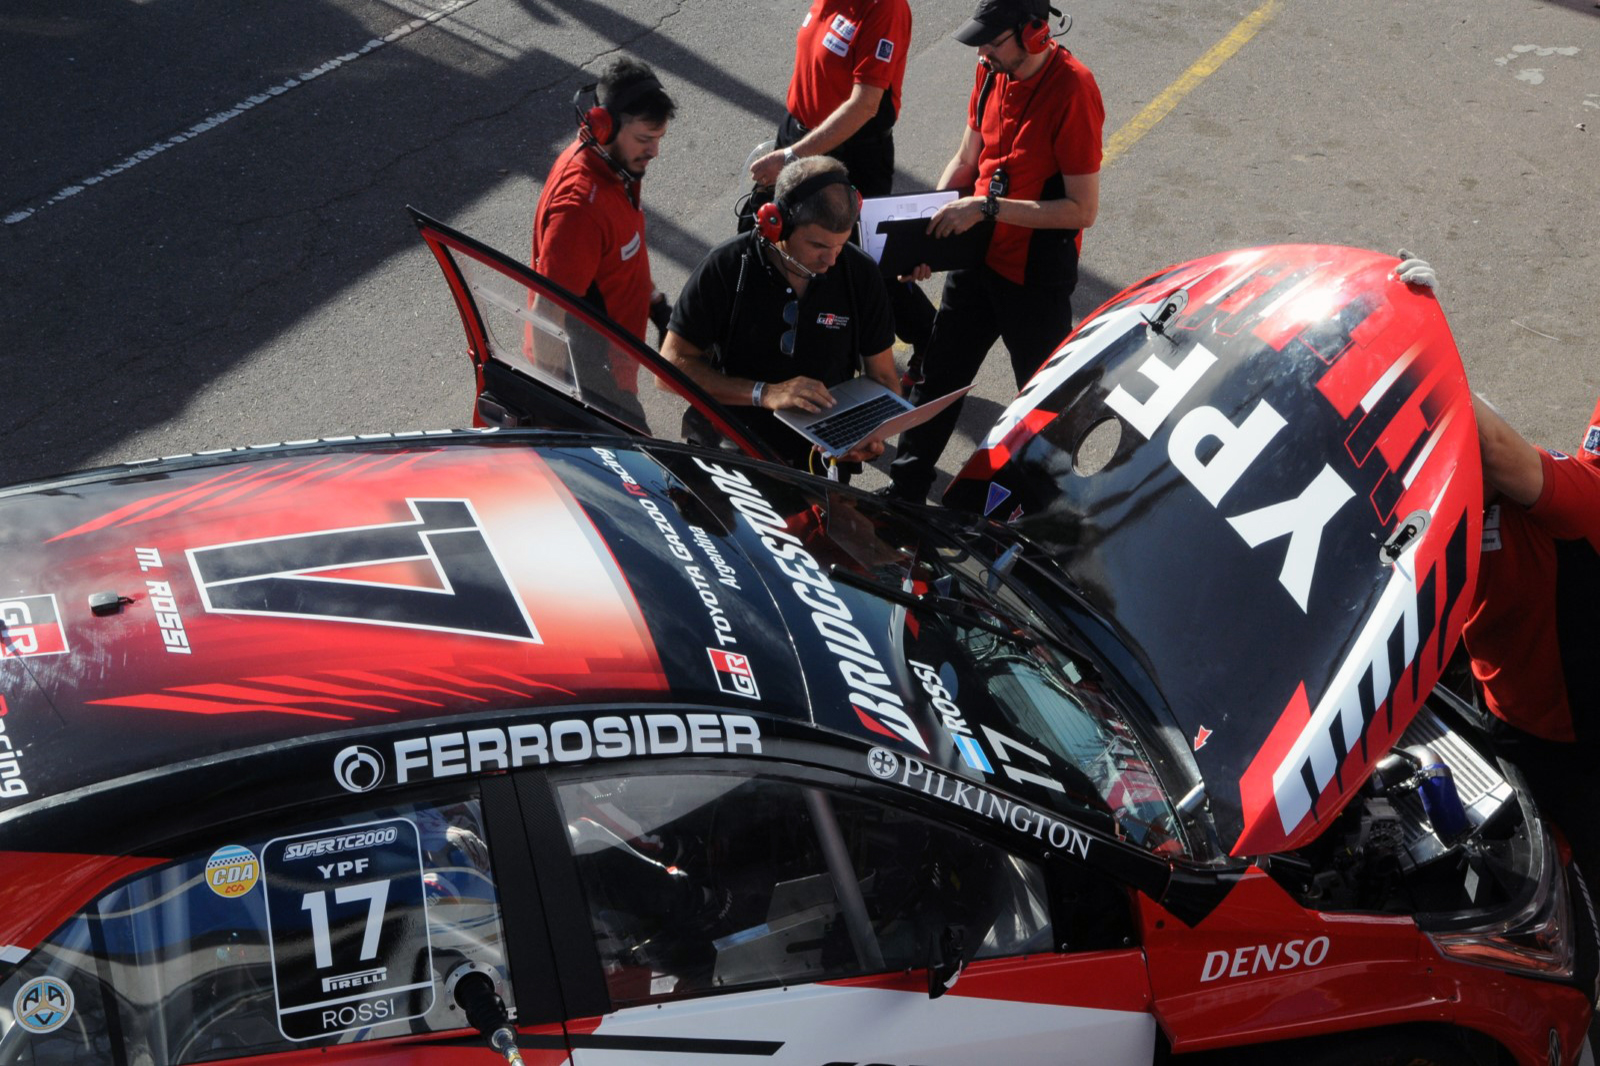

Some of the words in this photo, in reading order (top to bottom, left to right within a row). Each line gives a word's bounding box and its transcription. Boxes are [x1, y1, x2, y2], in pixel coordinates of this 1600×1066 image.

[591, 446, 648, 497] Racing
[1104, 342, 1357, 615] YPF
[638, 498, 693, 562] GAZOO
[688, 525, 742, 590] Argentina
[145, 580, 192, 655] ROSSI
[685, 565, 737, 647] TOYOTA
[692, 456, 930, 754] BRIDGESTONE
[908, 659, 973, 735] ROSSI
[394, 714, 763, 784] FERROSIDER
[979, 723, 1066, 793] 17
[899, 754, 1093, 860] PILKINGTON
[212, 864, 254, 886] CDA
[317, 858, 369, 879] YPF
[301, 879, 391, 969] 17
[1200, 936, 1330, 982] DENSO
[322, 967, 387, 992] PIRELLI
[322, 999, 394, 1029] ROSSI
